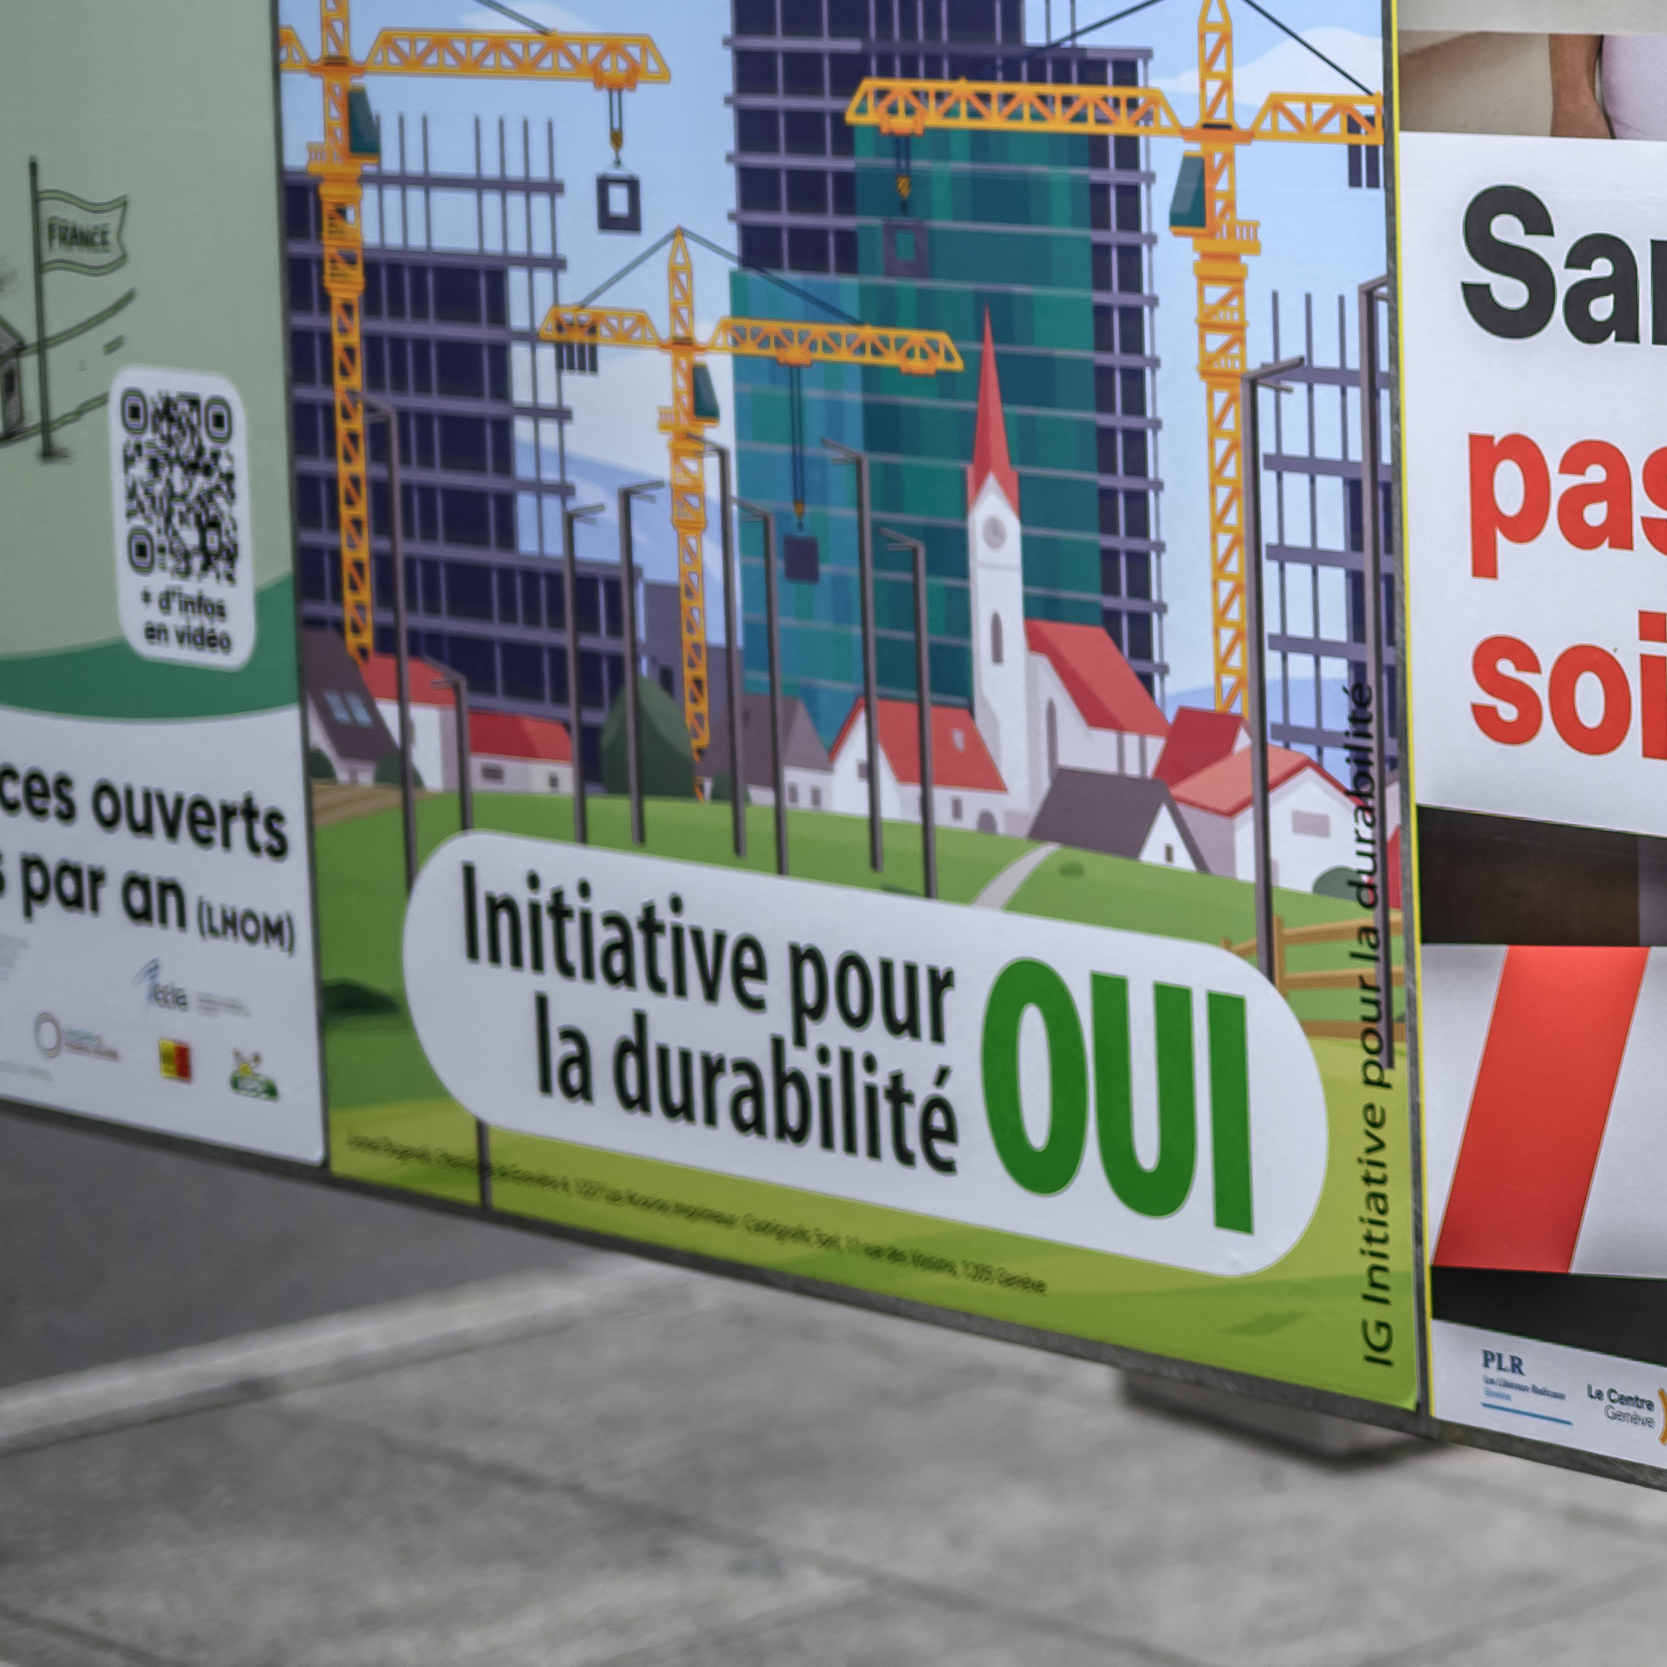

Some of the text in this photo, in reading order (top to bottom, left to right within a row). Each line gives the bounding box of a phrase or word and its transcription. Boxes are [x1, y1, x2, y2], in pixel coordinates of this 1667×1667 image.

[48, 216, 110, 252] FRANCE
[144, 615, 231, 655] en vidéo
[91, 777, 288, 863] ouverts
[20, 852, 105, 922] par
[121, 870, 186, 932] an
[197, 895, 294, 958] (LHOM)
[461, 861, 955, 1048] Initiative pour
[1343, 682, 1394, 1368] IG Initiative pour la durabilité
[535, 991, 593, 1103] la
[613, 1008, 958, 1174] durabilité
[980, 957, 1254, 1234] OUI
[1482, 1349, 1525, 1376] PLR
[1587, 1383, 1655, 1412] Le Centre
[1604, 1404, 1655, 1429] Genève
